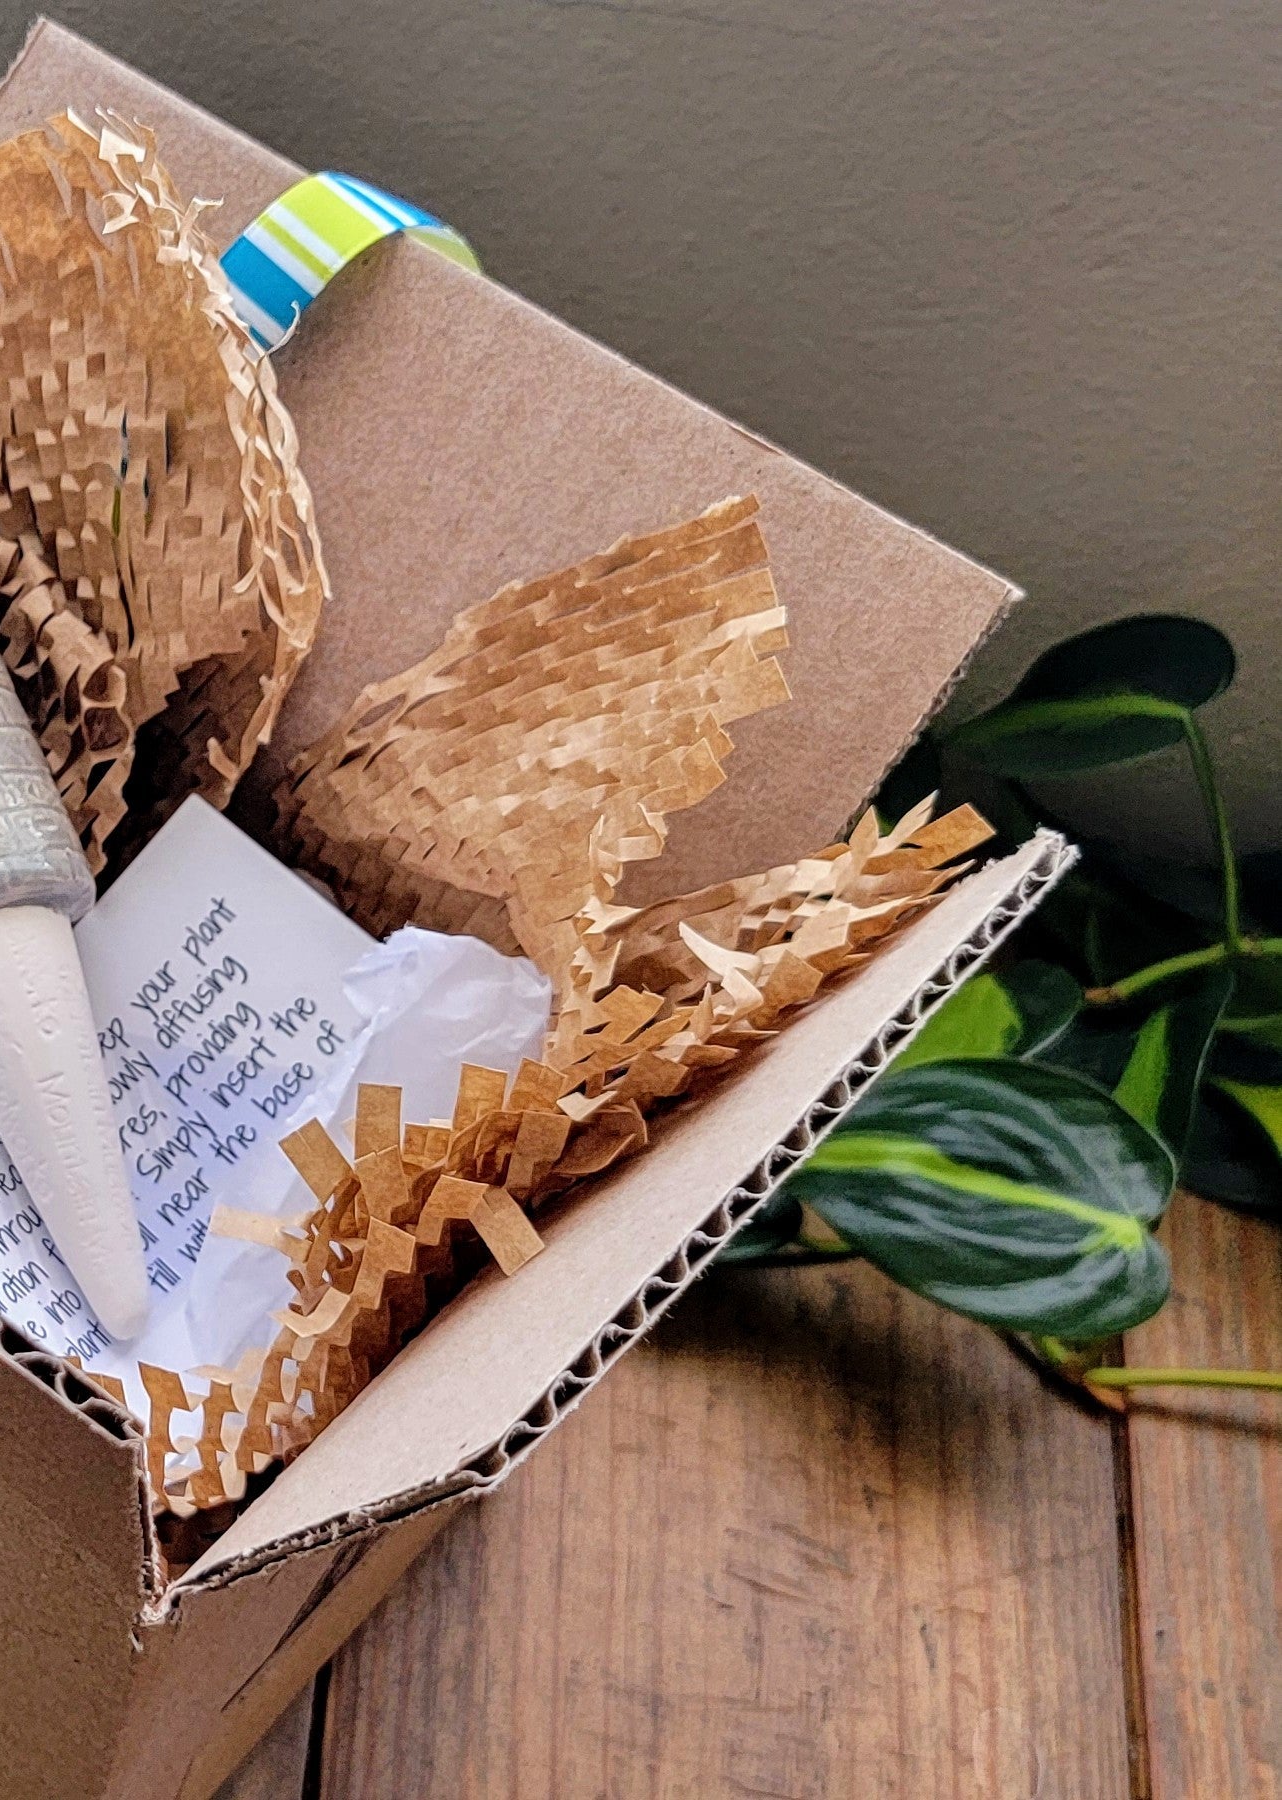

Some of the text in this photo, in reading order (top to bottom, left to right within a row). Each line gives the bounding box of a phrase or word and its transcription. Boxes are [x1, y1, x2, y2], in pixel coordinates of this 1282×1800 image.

[130, 960, 177, 1022] your
[182, 897, 237, 966] plant
[153, 955, 249, 1049] diffusing
[136, 1110, 218, 1184] Simply
[203, 1035, 277, 1108] insert
[269, 997, 316, 1038] the
[163, 1001, 261, 1107] providing
[38, 1287, 82, 1326] into
[156, 1167, 209, 1227] near
[209, 1123, 256, 1165] the
[250, 1062, 313, 1119] base
[317, 1019, 345, 1056] of
